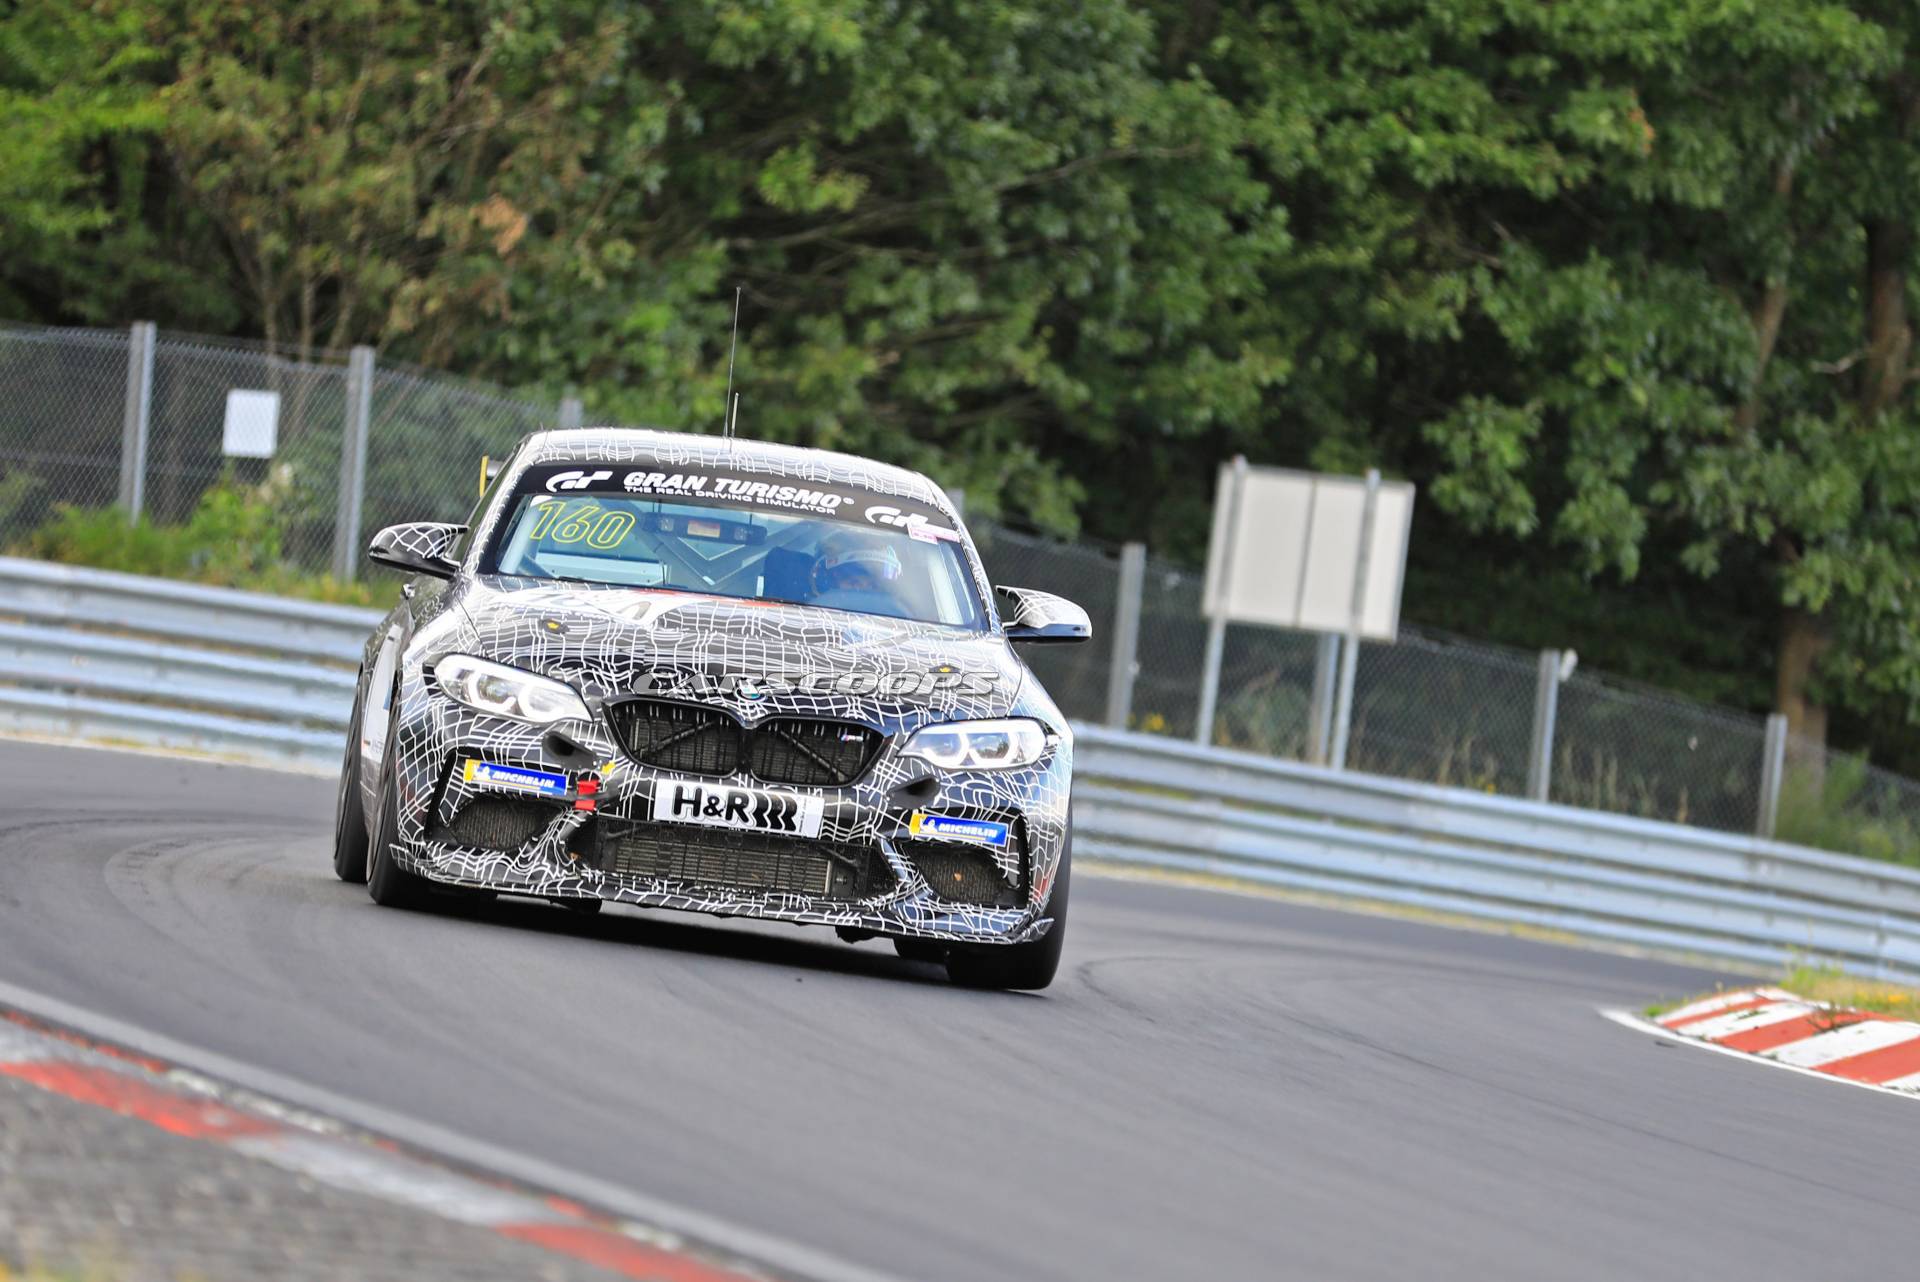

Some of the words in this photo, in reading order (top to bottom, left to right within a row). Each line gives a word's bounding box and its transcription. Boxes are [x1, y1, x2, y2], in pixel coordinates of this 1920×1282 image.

[623, 471, 708, 492] GRAN
[623, 486, 652, 494] THE
[656, 487, 692, 497] REAL
[695, 490, 753, 503] DRIVING
[756, 497, 836, 516] SIMULATOR
[530, 501, 636, 550] 160
[491, 770, 556, 788] MICHELIN
[673, 785, 750, 823] H&R
[938, 823, 998, 838] MICHELIN
